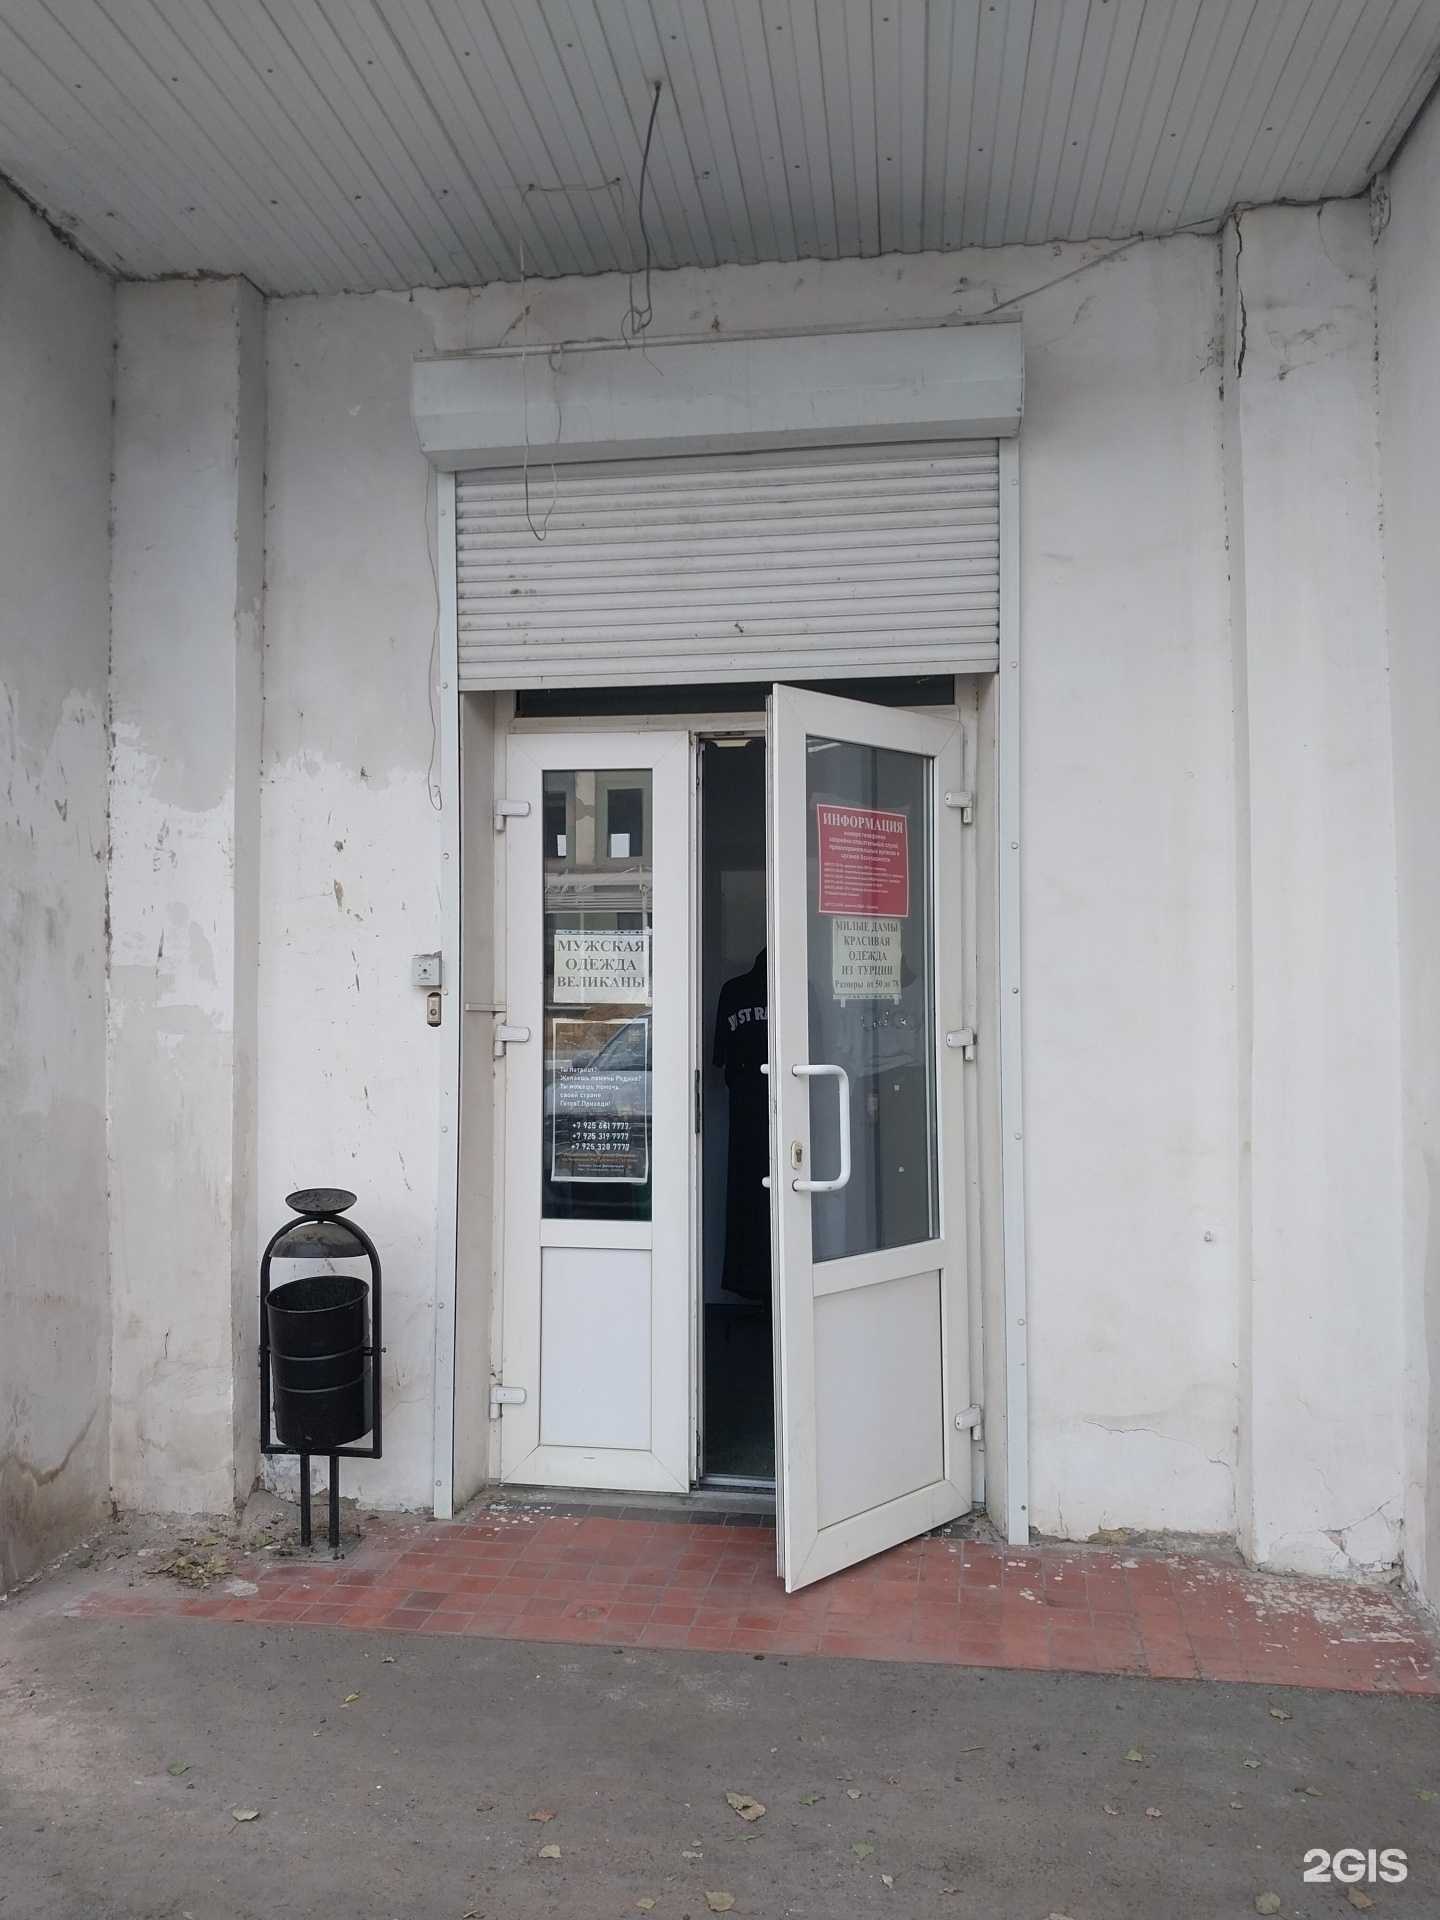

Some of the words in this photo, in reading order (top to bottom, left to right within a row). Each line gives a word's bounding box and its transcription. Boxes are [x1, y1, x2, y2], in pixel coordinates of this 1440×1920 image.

[823, 812, 904, 833] ИНФОРМАЦИЯ
[835, 919, 867, 931] МИЛЫЕ
[871, 921, 898, 932] ДАМЫ
[557, 940, 645, 952] МУЖСКАЯ
[843, 935, 890, 946] КРАСИВАЯ
[848, 950, 887, 961] ОДЕЖДА
[565, 958, 637, 971] ОДЕЖДА
[841, 965, 853, 975] ИЗ
[855, 965, 893, 976] ТУРЦИИ
[557, 975, 645, 988] ВЕЛИКАНЫ
[834, 979, 864, 990] Размеры
[572, 1121, 581, 1129] +7
[583, 1121, 596, 1130] 925
[583, 1132, 596, 1140] 925
[598, 1132, 610, 1140] 319
[612, 1132, 629, 1140] 7777
